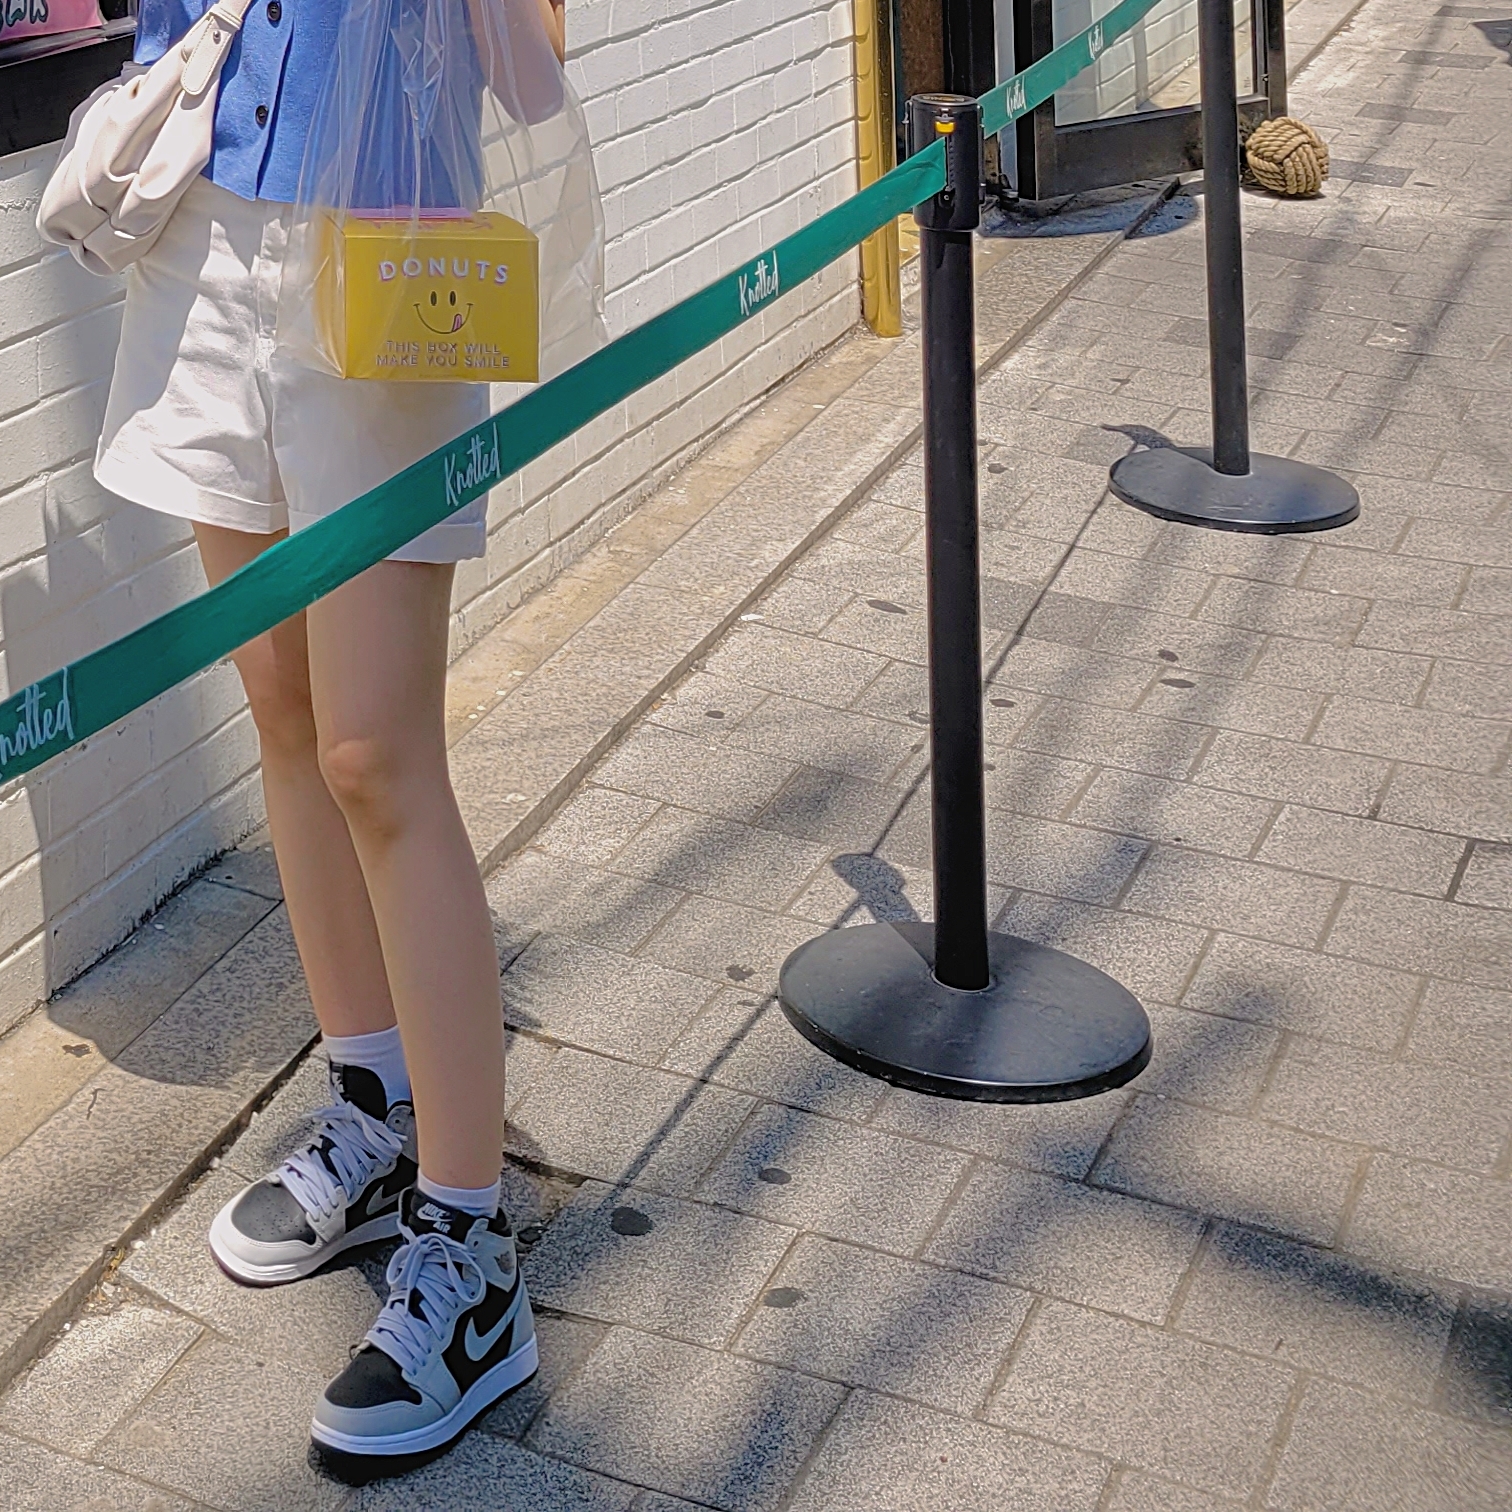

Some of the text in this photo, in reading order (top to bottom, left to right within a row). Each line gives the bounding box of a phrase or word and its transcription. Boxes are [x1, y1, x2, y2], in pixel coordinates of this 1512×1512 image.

[378, 257, 510, 285] DONUTS
[738, 249, 779, 316] Knotted
[386, 340, 501, 354] THIS BOX WILL
[375, 354, 510, 369] MAKE YOU SMILE
[444, 421, 501, 506] Knotted
[424, 1202, 447, 1219] NIKE
[432, 1220, 451, 1234] AIR
